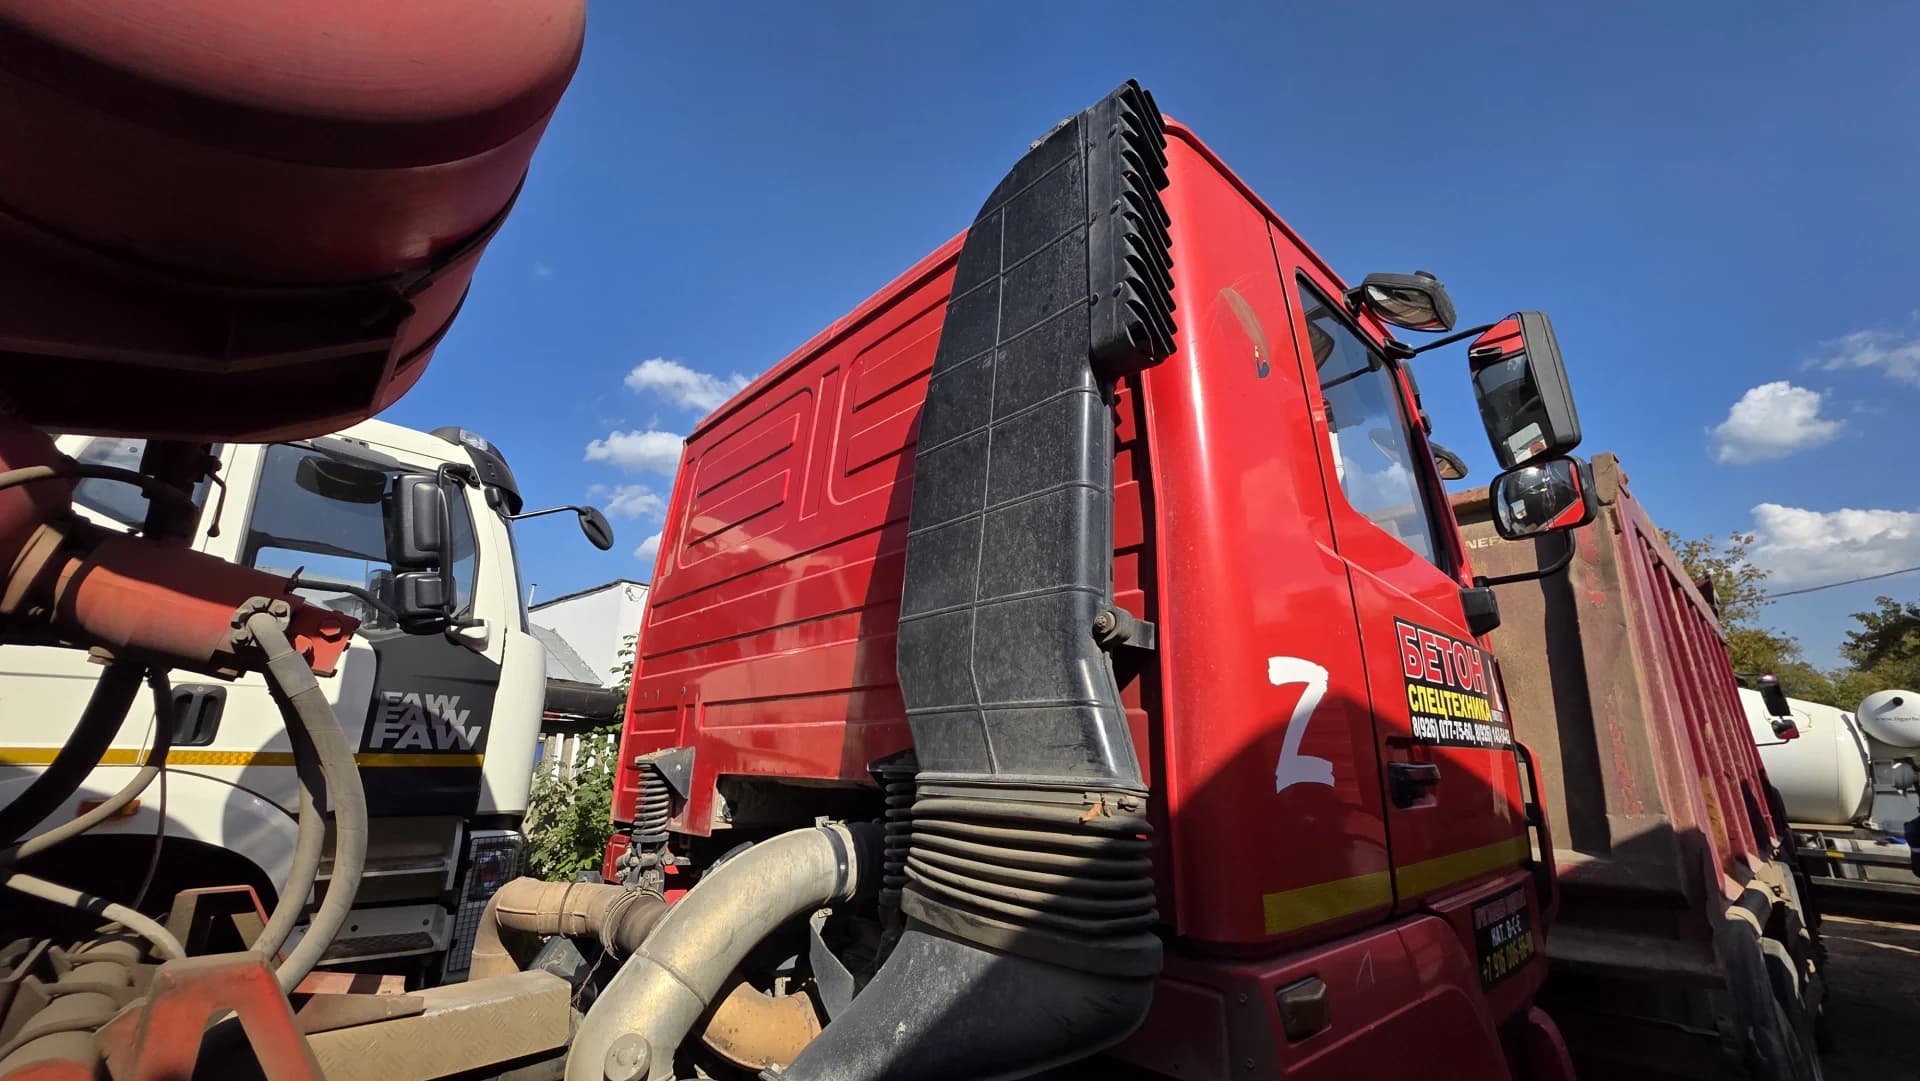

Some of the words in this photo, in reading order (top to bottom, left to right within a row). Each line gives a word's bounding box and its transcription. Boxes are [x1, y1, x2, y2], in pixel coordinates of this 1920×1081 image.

[1396, 621, 1488, 695] БЕТОН
[1407, 684, 1493, 722] СПЕЦТЕХНИКА
[369, 724, 482, 750] FAW
[1412, 716, 1439, 744] 8(926)
